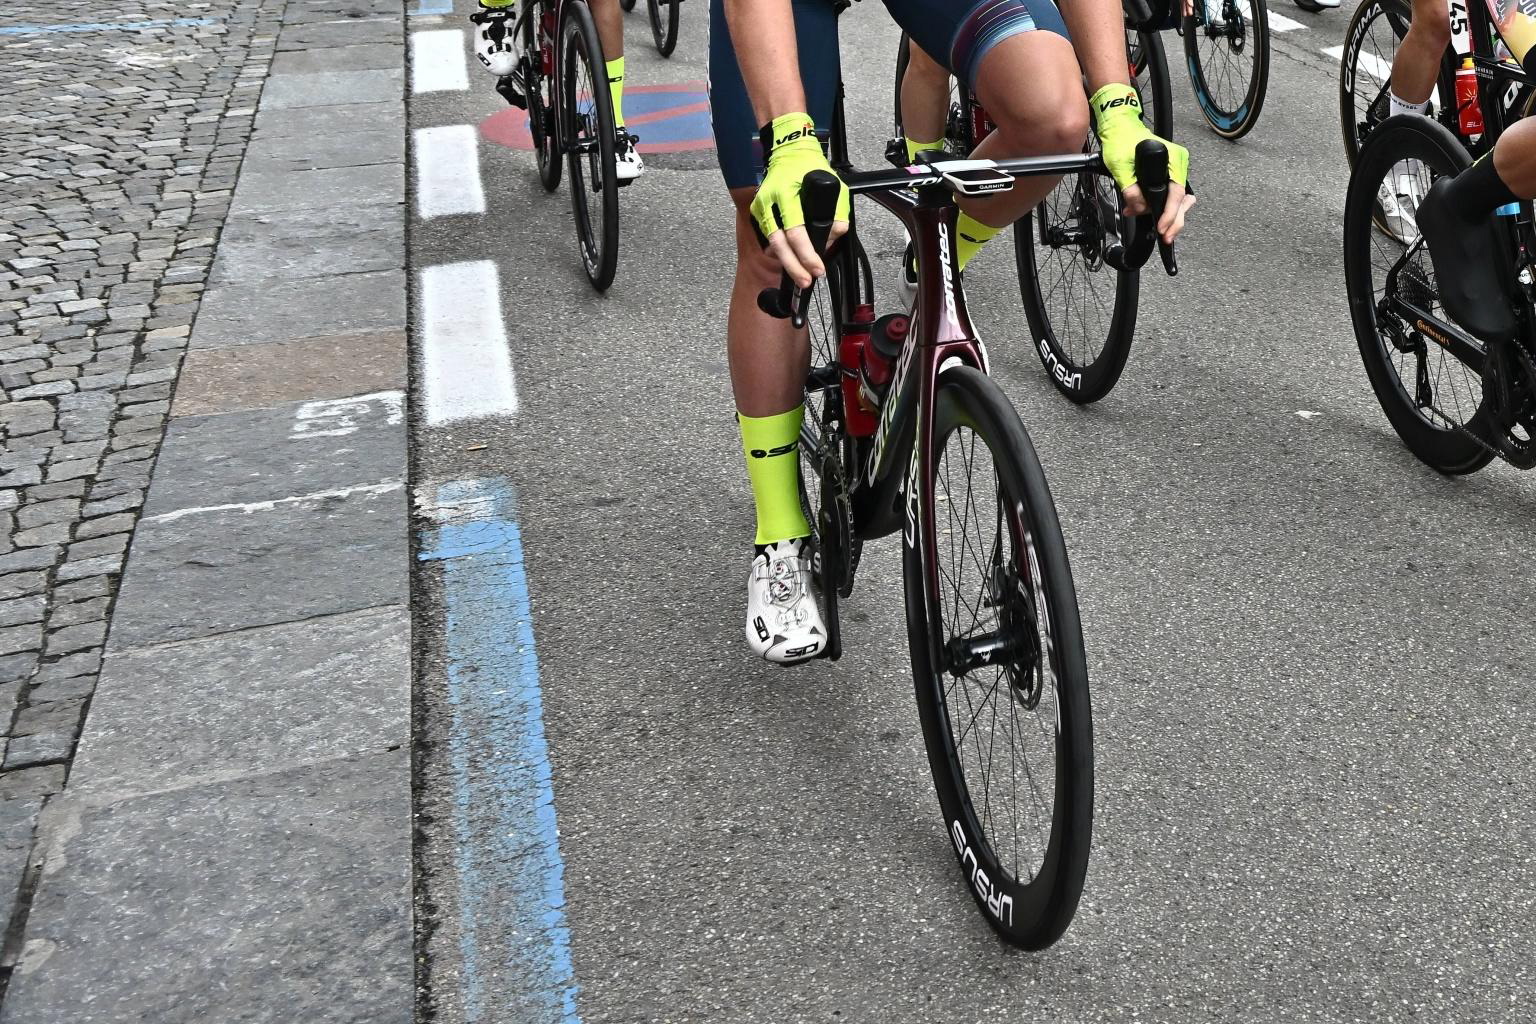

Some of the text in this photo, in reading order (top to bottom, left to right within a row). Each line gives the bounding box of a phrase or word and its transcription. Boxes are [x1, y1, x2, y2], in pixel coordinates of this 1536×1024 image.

[1450, 2, 1468, 35] 45
[1099, 94, 1139, 112] velo
[978, 182, 1006, 191] GARMIN
[1039, 338, 1082, 391] URSUS
[951, 819, 1014, 930] URSUS
